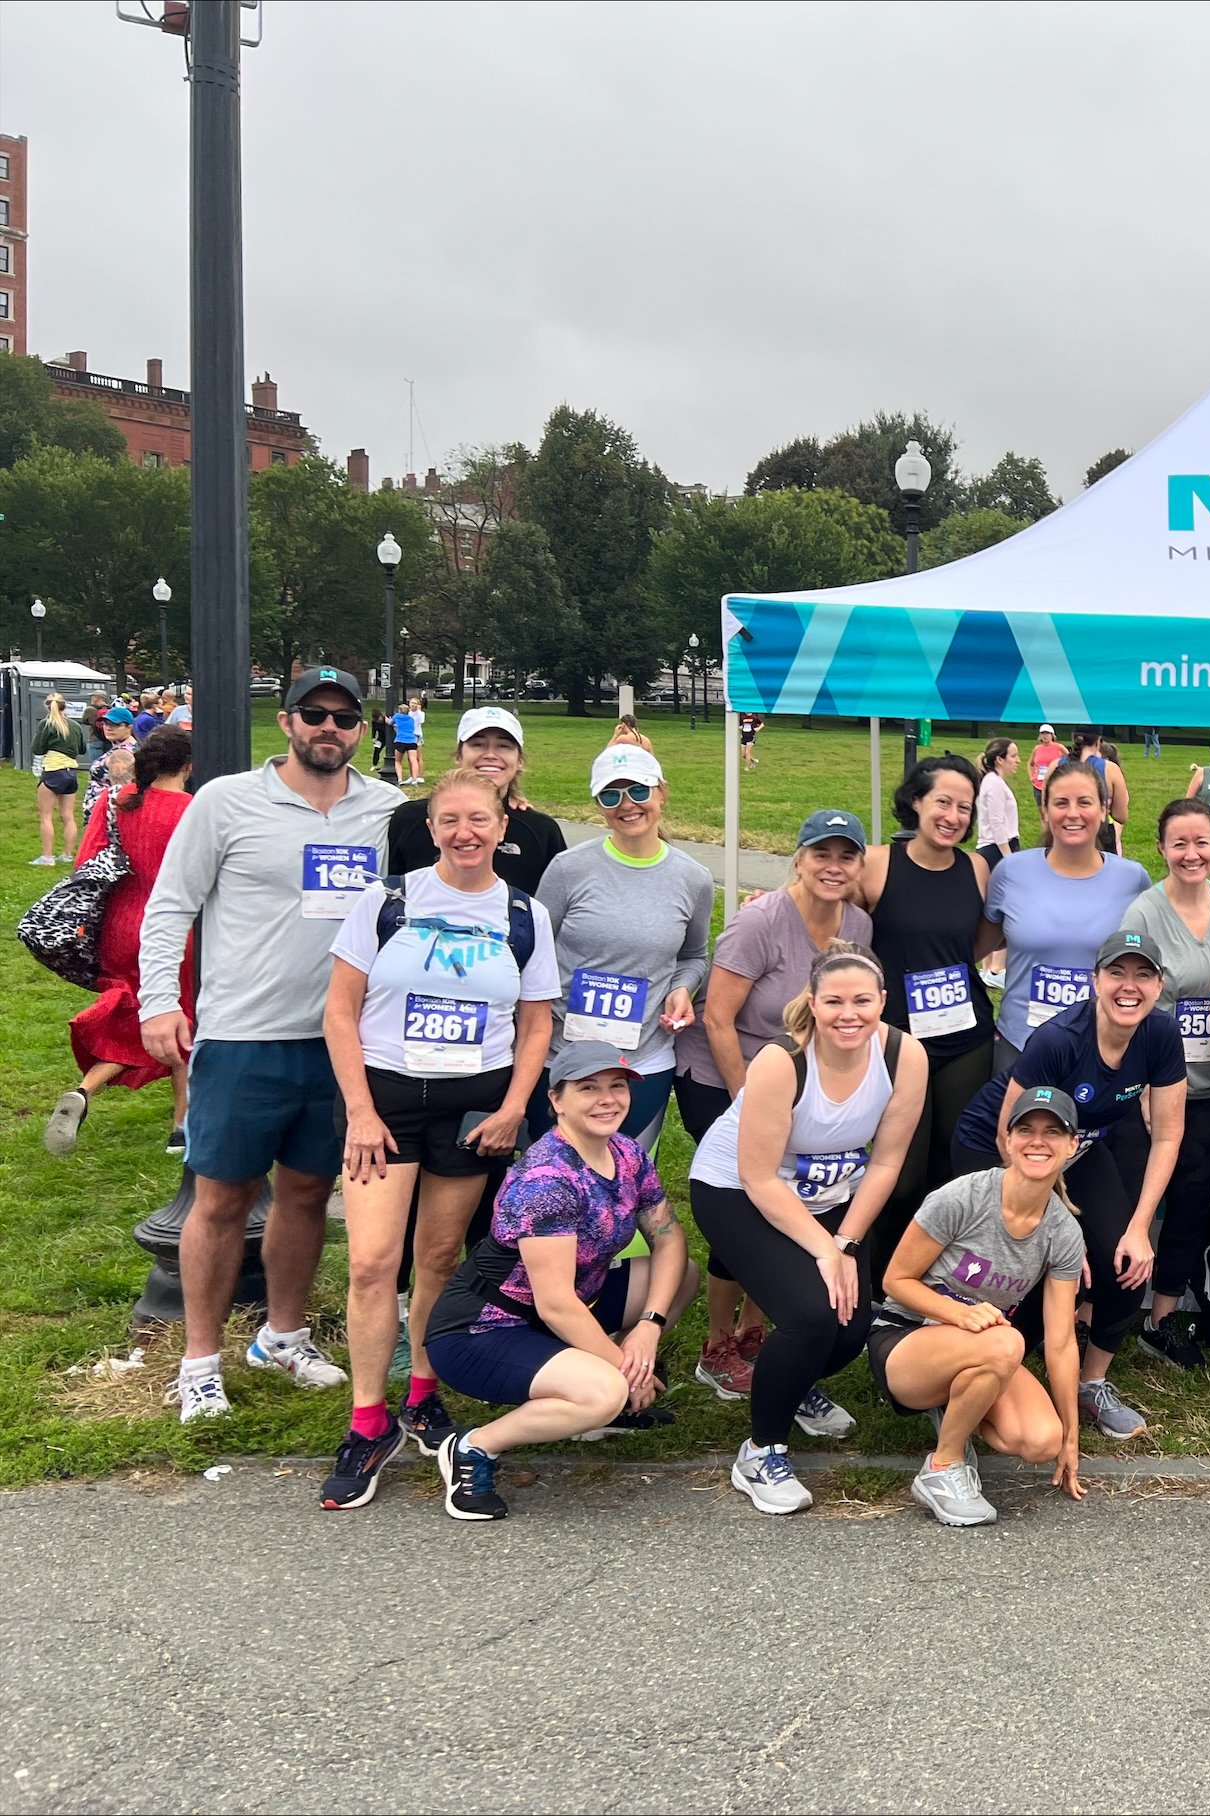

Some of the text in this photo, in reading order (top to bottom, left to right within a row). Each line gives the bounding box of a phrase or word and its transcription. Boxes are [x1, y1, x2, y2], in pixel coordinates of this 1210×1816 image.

[312, 847, 335, 855] Boston
[582, 972, 620, 984] Boston 10K
[920, 976, 948, 986] WOMEN
[1045, 974, 1072, 982] WOMEN
[588, 981, 619, 990] WOMEN
[910, 980, 968, 1010] 1965
[1035, 980, 1090, 1006] 1964
[422, 1003, 456, 1012] WOMEN
[582, 989, 632, 1018] 119
[406, 1012, 478, 1042] 2861
[1080, 1088, 1088, 1097] 2
[808, 1162, 856, 1186] 618
[988, 1272, 1030, 1292] NYU
